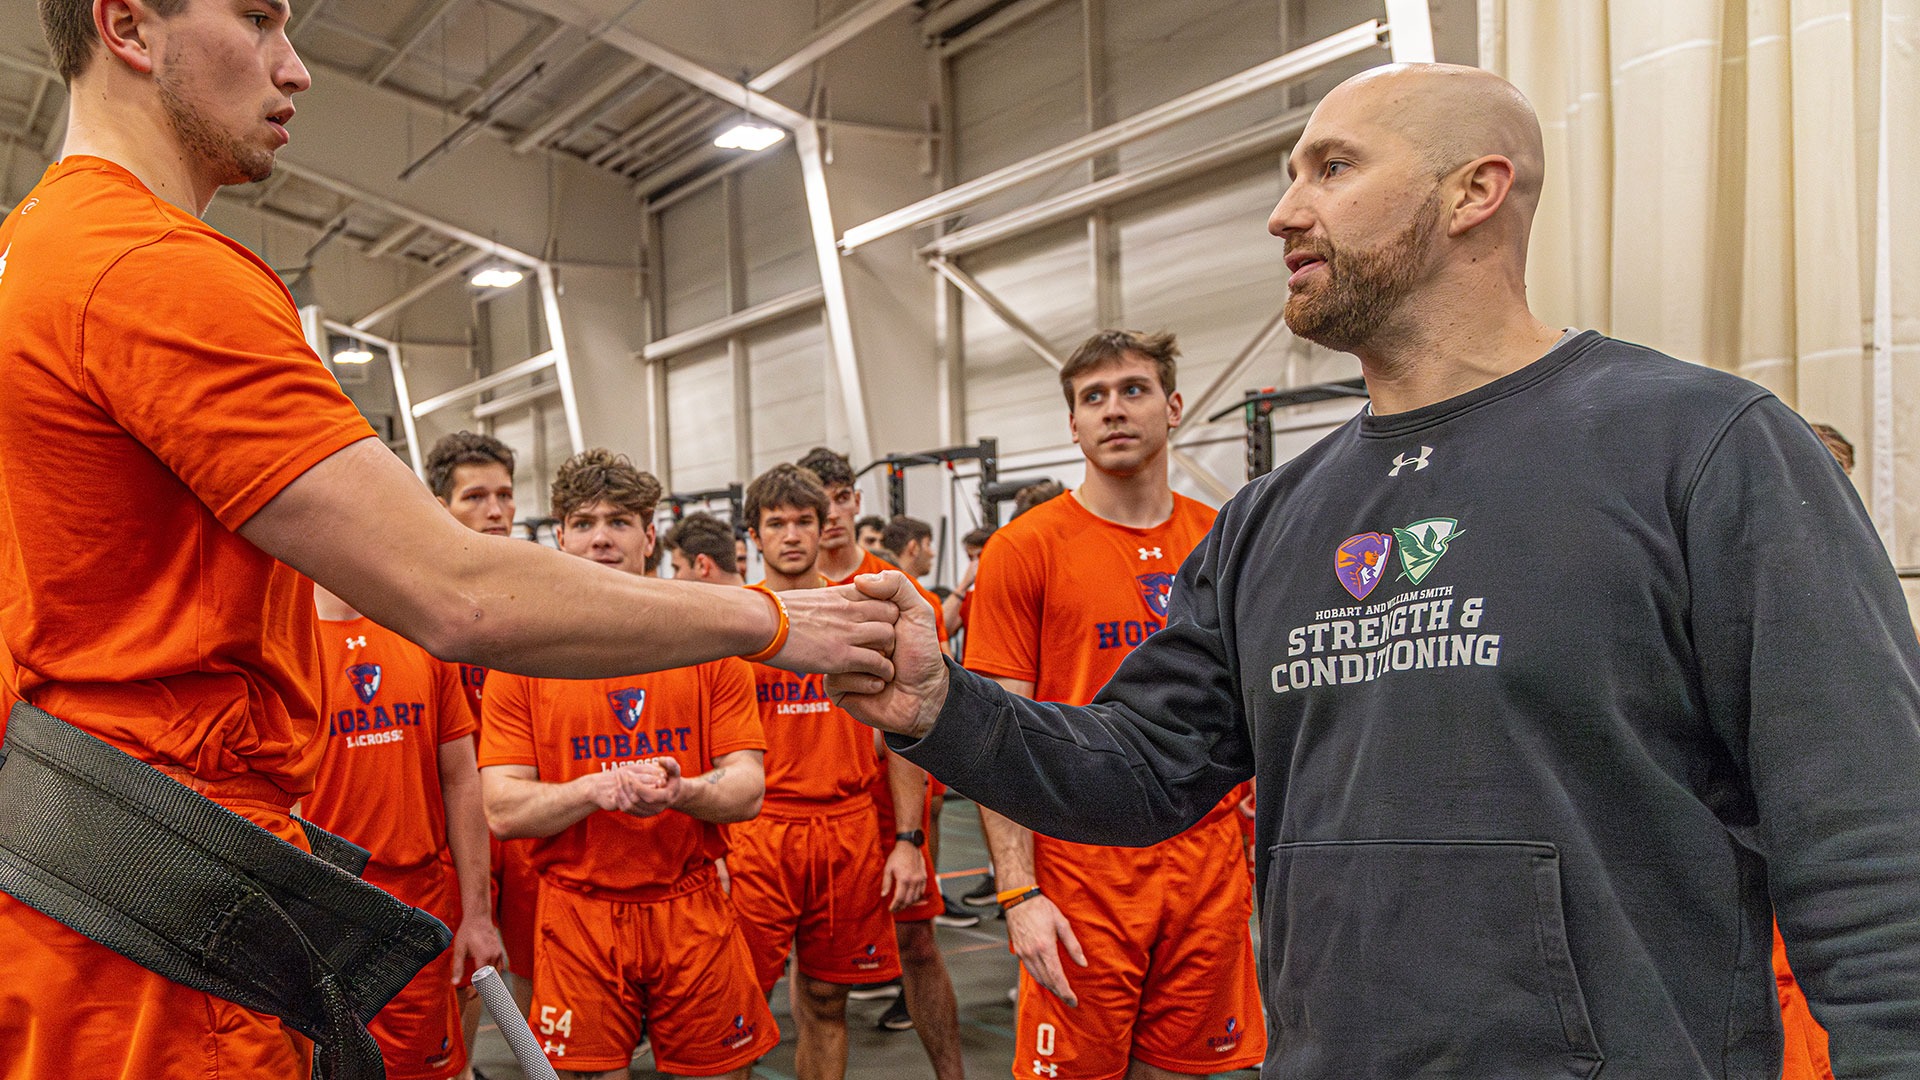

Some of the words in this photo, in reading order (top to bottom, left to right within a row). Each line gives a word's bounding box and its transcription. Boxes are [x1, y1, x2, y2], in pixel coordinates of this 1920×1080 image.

[1315, 606, 1362, 621] HOBART
[1365, 602, 1387, 616] AND
[1418, 586, 1453, 600] SMITH
[1288, 599, 1454, 656] STRENGTH
[1459, 597, 1484, 629] &
[1271, 634, 1500, 694] CONDITIONING
[757, 681, 828, 702] HOBA
[777, 701, 830, 715] LACROSSE
[571, 727, 691, 760] HOBART
[539, 1005, 573, 1039] 54
